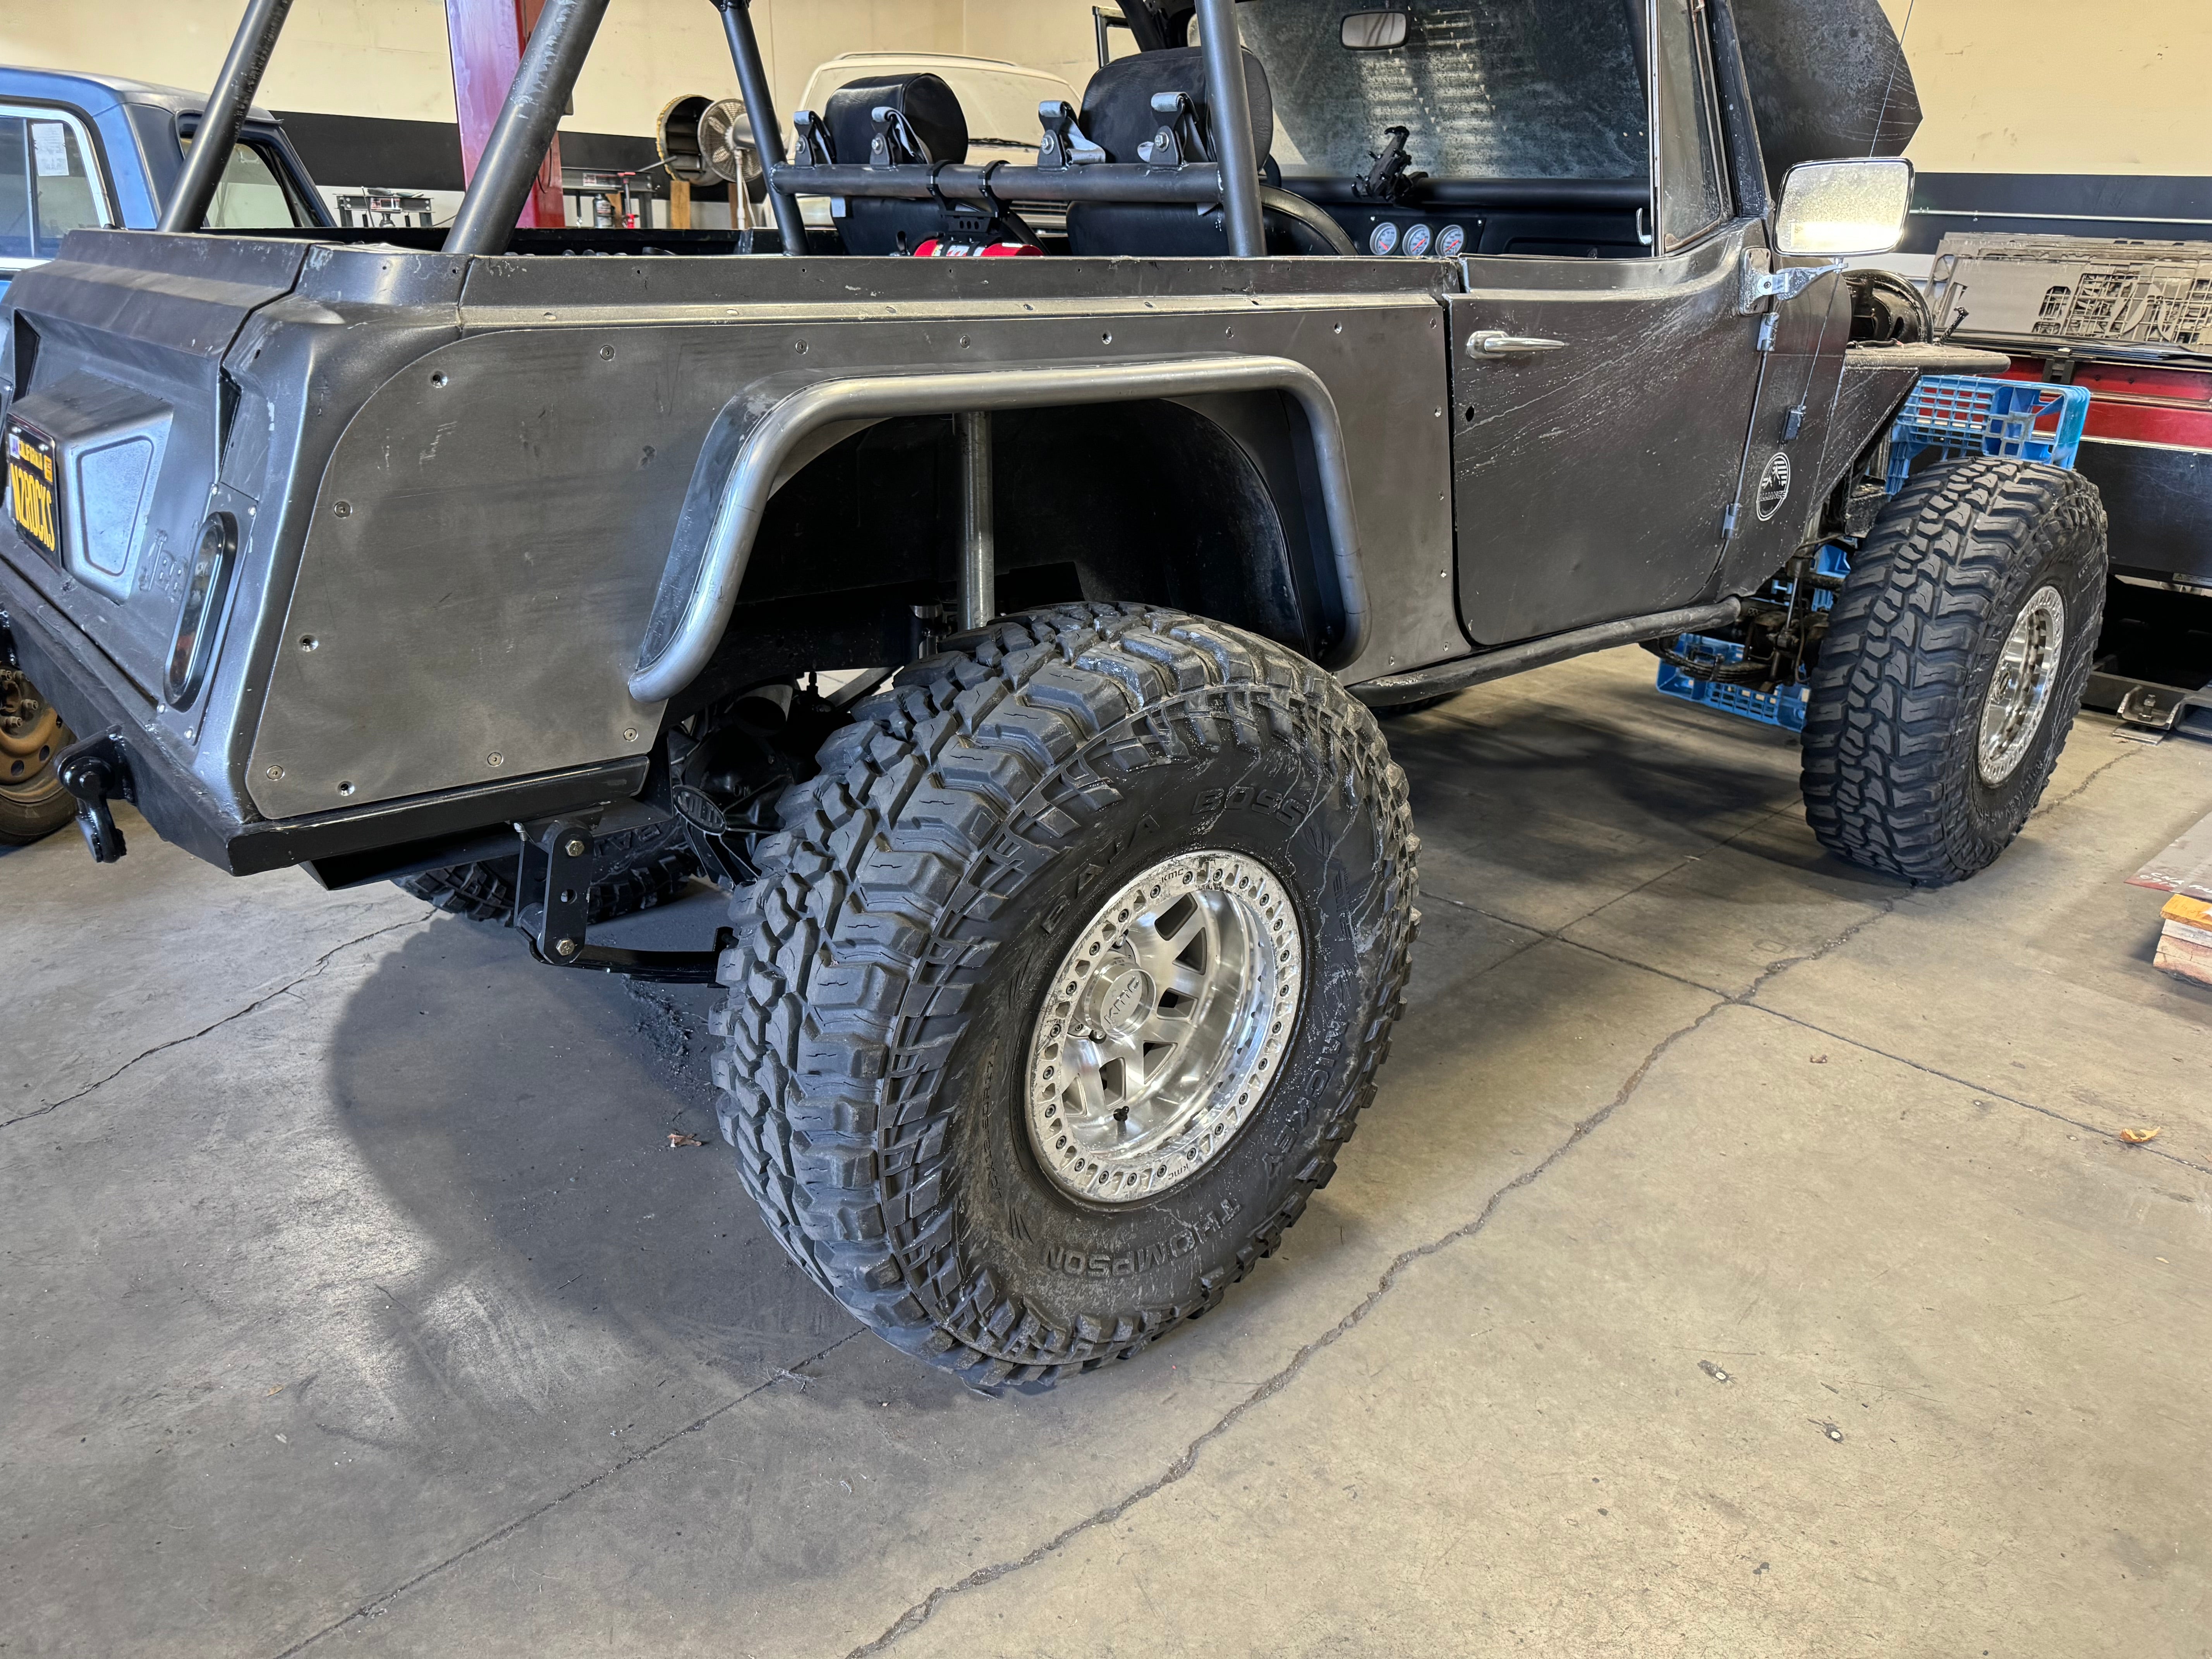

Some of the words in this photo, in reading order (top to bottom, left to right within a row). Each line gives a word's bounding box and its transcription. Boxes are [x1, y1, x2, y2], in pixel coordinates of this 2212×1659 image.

[10, 463, 55, 552] N2ROCKS
[1191, 787, 1307, 827] BOSS
[1161, 868, 1184, 883] KMC
[1104, 975, 1141, 1029] KMC
[1262, 1020, 1348, 1180] MICKEY
[1168, 1163, 1188, 1180] KMC
[1042, 1199, 1242, 1276] THOMPSON
